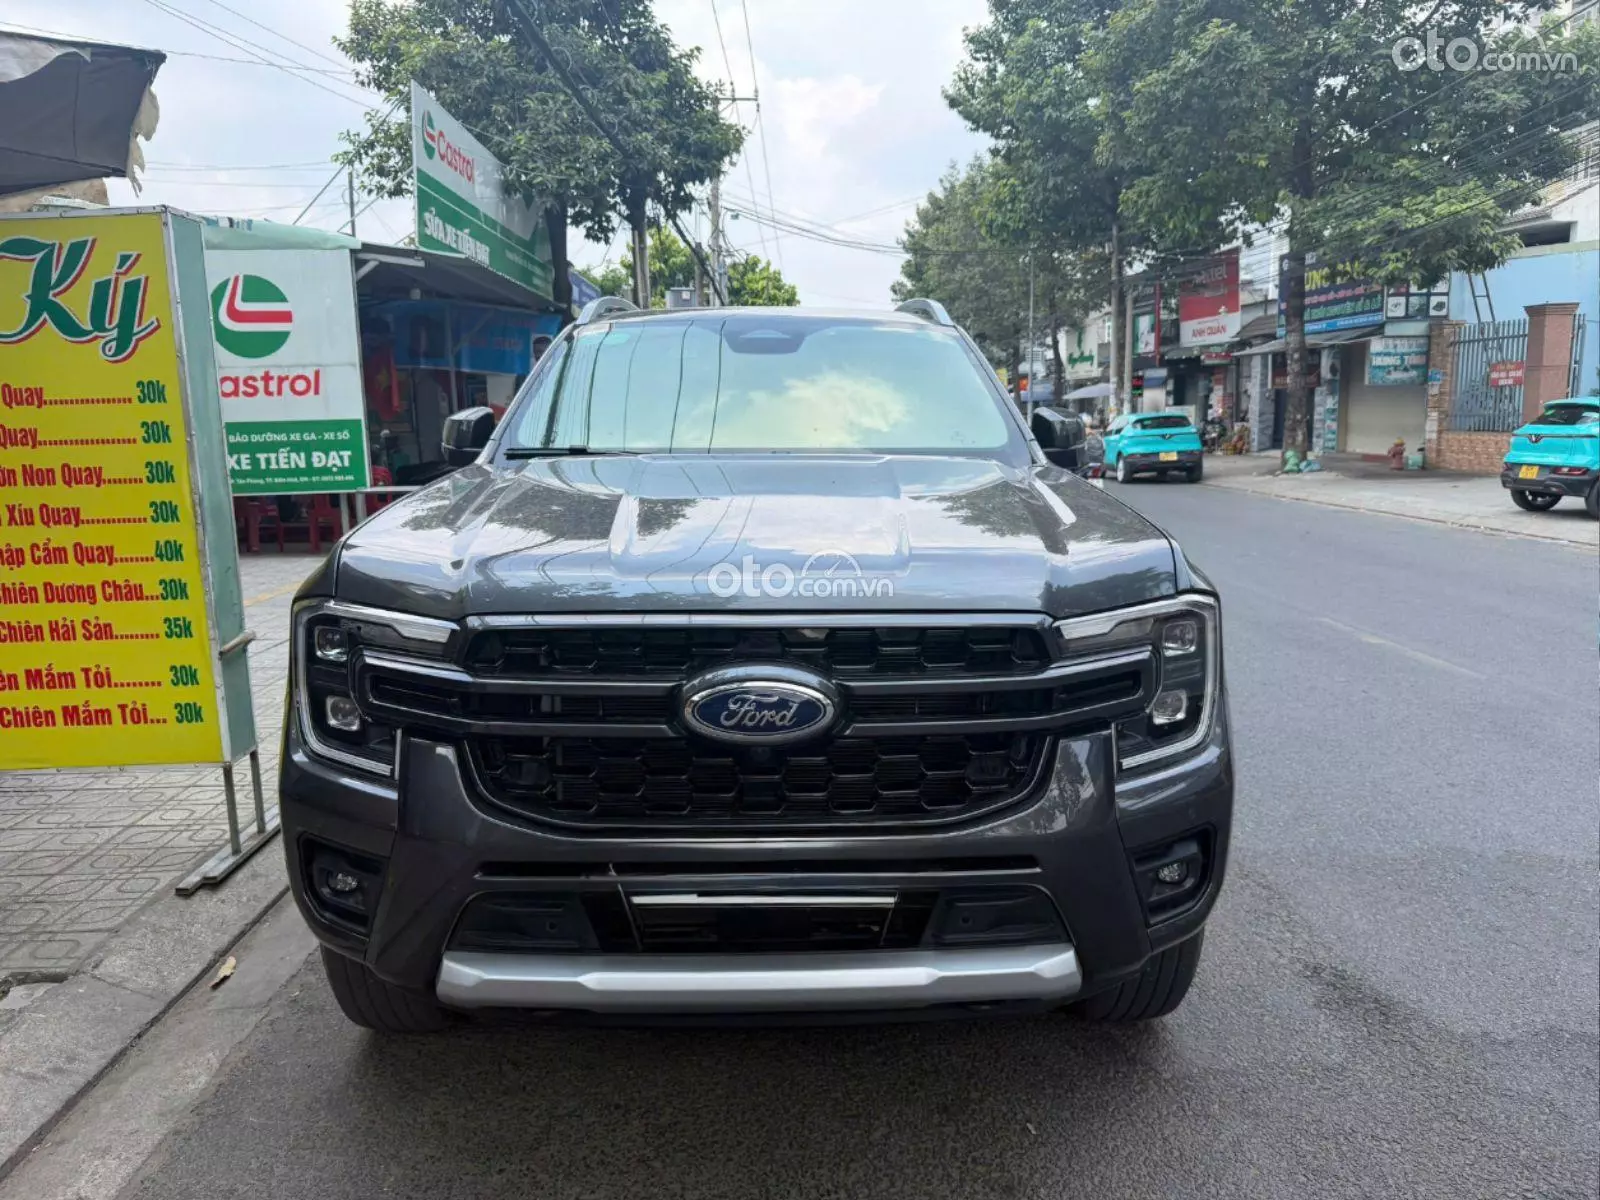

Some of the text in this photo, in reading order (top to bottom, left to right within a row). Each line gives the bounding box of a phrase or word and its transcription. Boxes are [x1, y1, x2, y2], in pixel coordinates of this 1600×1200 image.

[437, 130, 474, 184] Castrol
[136, 380, 167, 404] 30k
[140, 420, 172, 443] 30k
[229, 432, 248, 443] BẢO
[250, 431, 287, 442] DƯỠNG
[289, 432, 301, 441] XE
[303, 432, 317, 441] GA
[323, 431, 335, 440] XE
[337, 430, 350, 440] SỐ
[227, 447, 352, 472] XE TIẾN ĐẠT
[22, 464, 56, 486] Non
[61, 463, 102, 487] Quay
[145, 461, 176, 484] 30k
[6, 503, 35, 526] Xíu
[39, 503, 81, 528] Quay
[149, 500, 181, 523] 30k
[30, 538, 69, 565] Cẩm
[73, 542, 114, 566] Quay
[154, 540, 184, 562] 40k
[0, 578, 190, 605] hiên Dương Châu 30k
[48, 617, 77, 642] Hải
[81, 616, 114, 641] Sản
[163, 616, 194, 639] 35k
[24, 663, 76, 690] Mắm
[80, 664, 112, 689] Tỏi
[169, 664, 200, 687] 30k
[0, 700, 204, 729] Chiên Mắm Tỏi 30k
[720, 695, 799, 728] Ford
